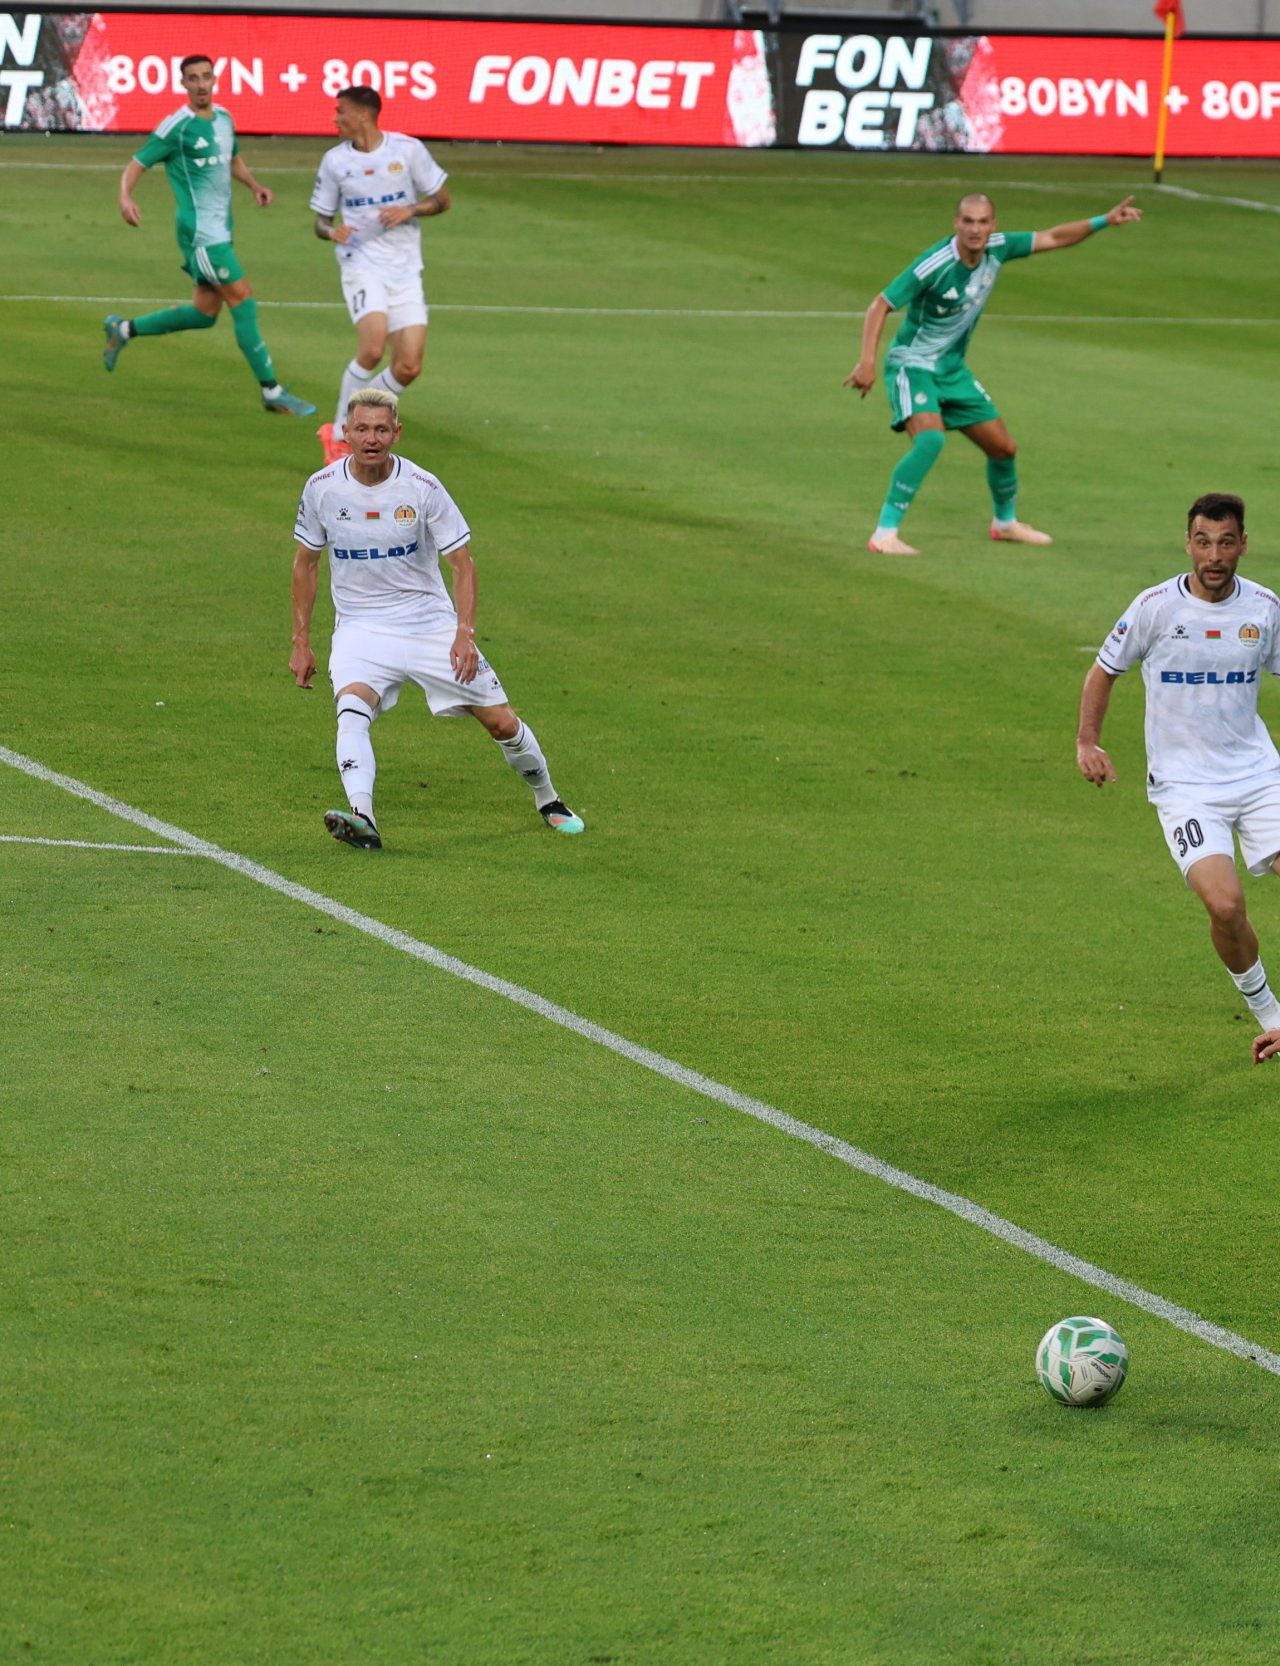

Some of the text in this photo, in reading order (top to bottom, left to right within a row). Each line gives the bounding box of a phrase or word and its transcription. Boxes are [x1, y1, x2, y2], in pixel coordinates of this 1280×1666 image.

[280, 63, 307, 92] +
[796, 33, 931, 88] FON
[469, 55, 714, 109] FONBET
[998, 76, 1148, 117] 80BYN
[798, 90, 935, 147] BET
[411, 472, 438, 490] FONBET
[334, 541, 419, 560] BELAZ
[1161, 670, 1257, 685] BELAZ
[1173, 818, 1204, 857] 30
